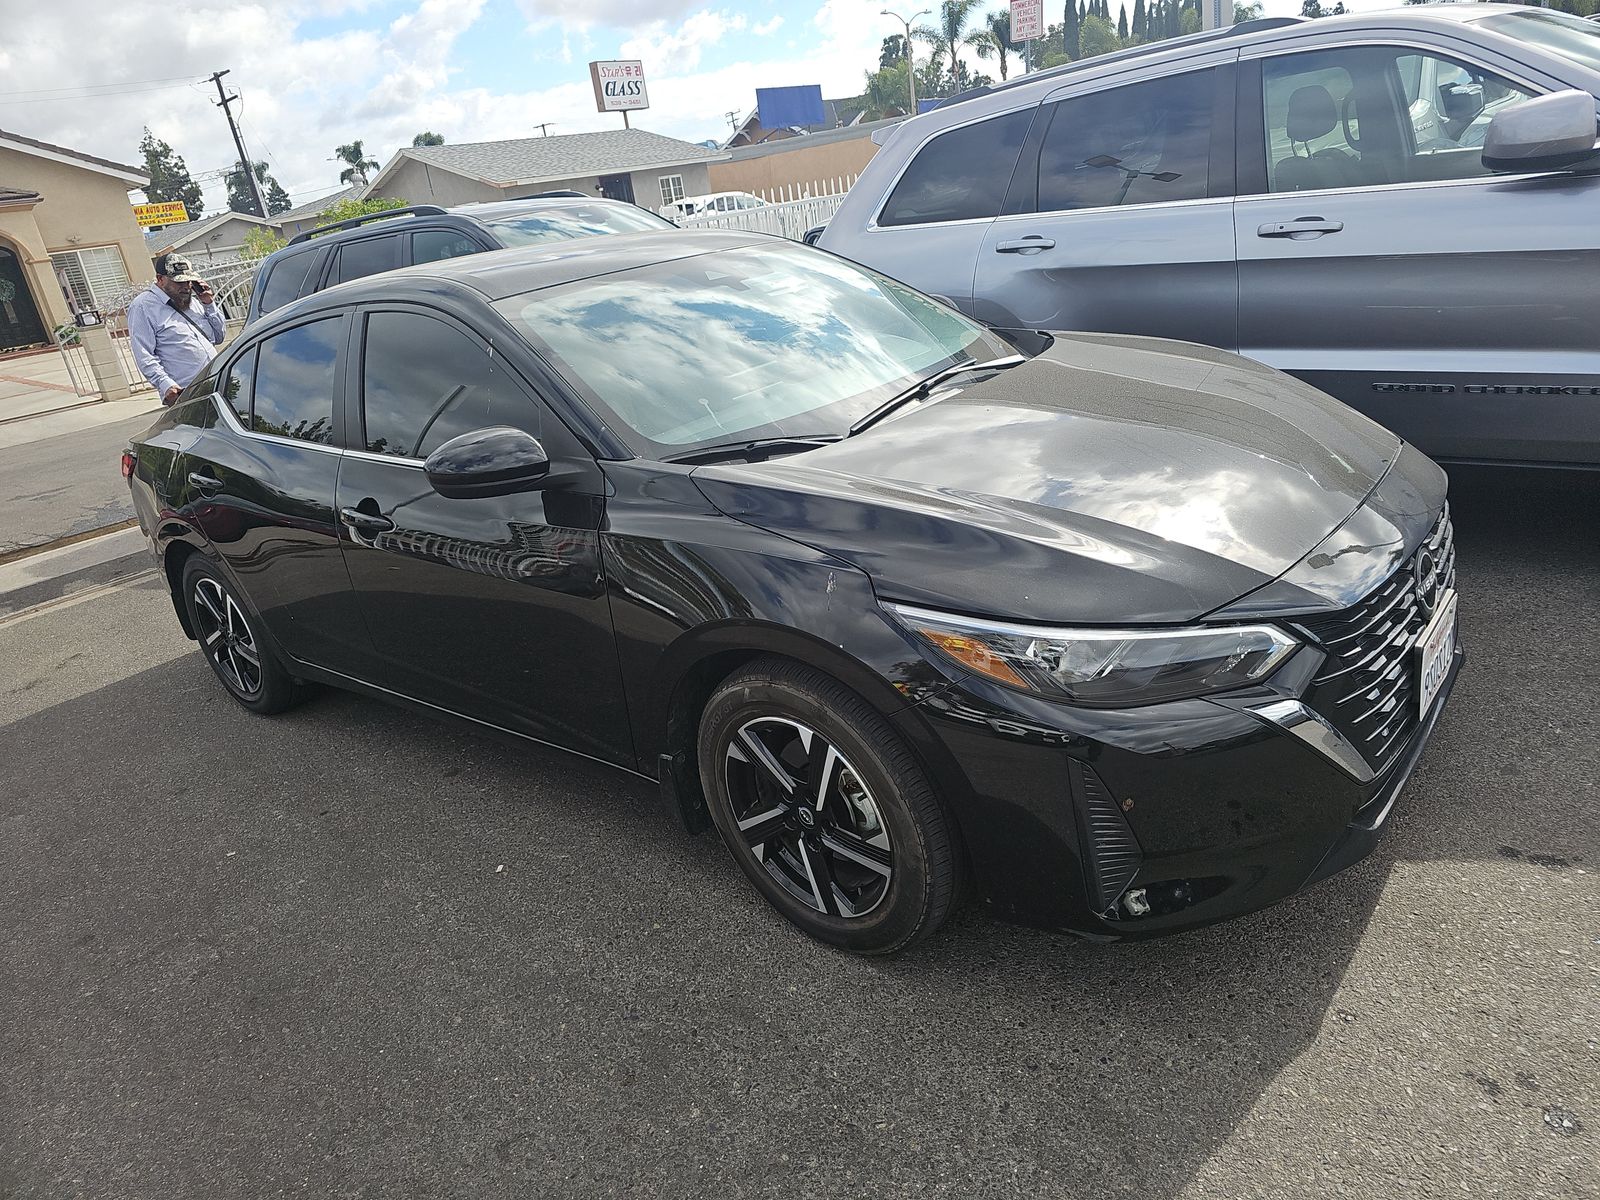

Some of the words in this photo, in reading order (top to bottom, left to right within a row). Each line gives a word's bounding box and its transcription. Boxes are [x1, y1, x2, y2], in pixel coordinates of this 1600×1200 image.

[1012, 0, 1040, 11] COMMERCIAL
[1016, 7, 1037, 18] VEHICLE
[1016, 15, 1037, 25] PARKING
[1016, 24, 1025, 33] ANY
[1026, 22, 1038, 32] TIME
[605, 80, 642, 97] GLASS
[146, 206, 160, 214] AUTO
[162, 203, 183, 213] SERVICE
[1371, 382, 1457, 394] GRAND
